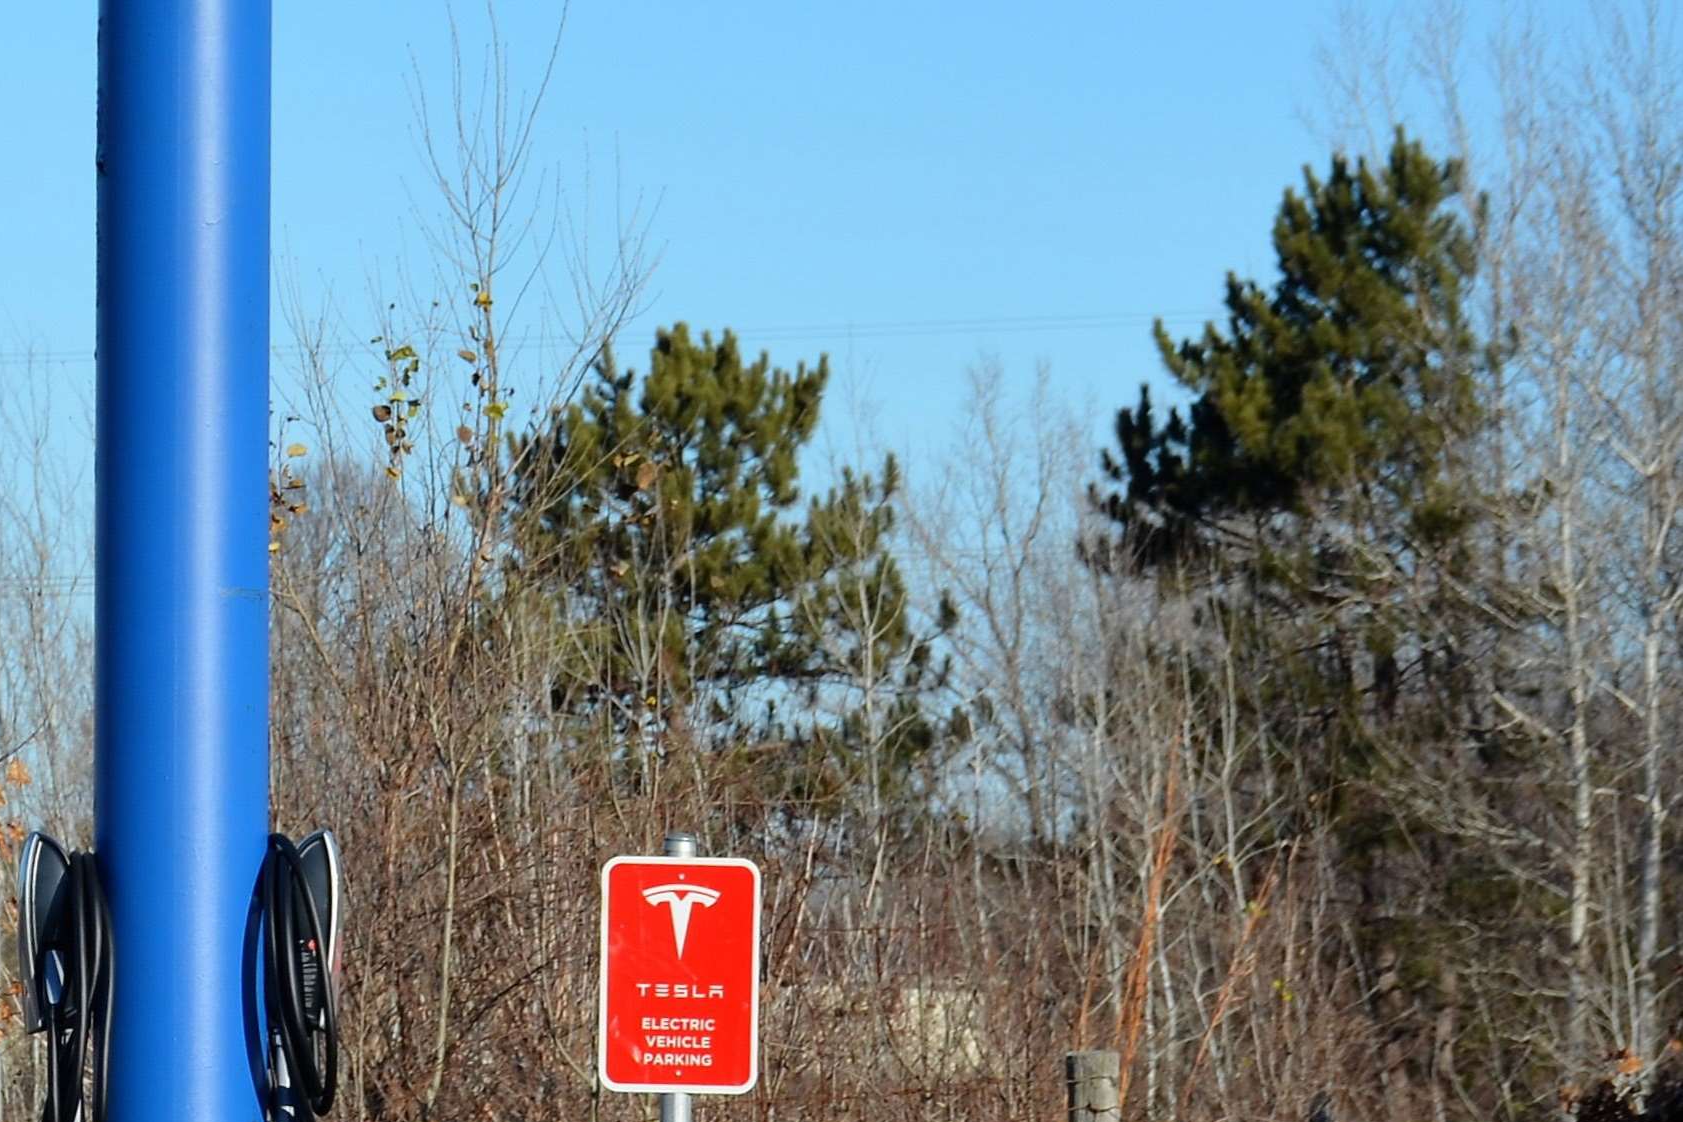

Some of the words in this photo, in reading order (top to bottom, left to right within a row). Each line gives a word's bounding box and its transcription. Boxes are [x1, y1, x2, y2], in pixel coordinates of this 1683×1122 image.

[635, 983, 724, 999] TESLA
[641, 1017, 716, 1031] ELECTRIC
[645, 1035, 711, 1049] VEHICLE
[643, 1052, 713, 1067] PARKING
